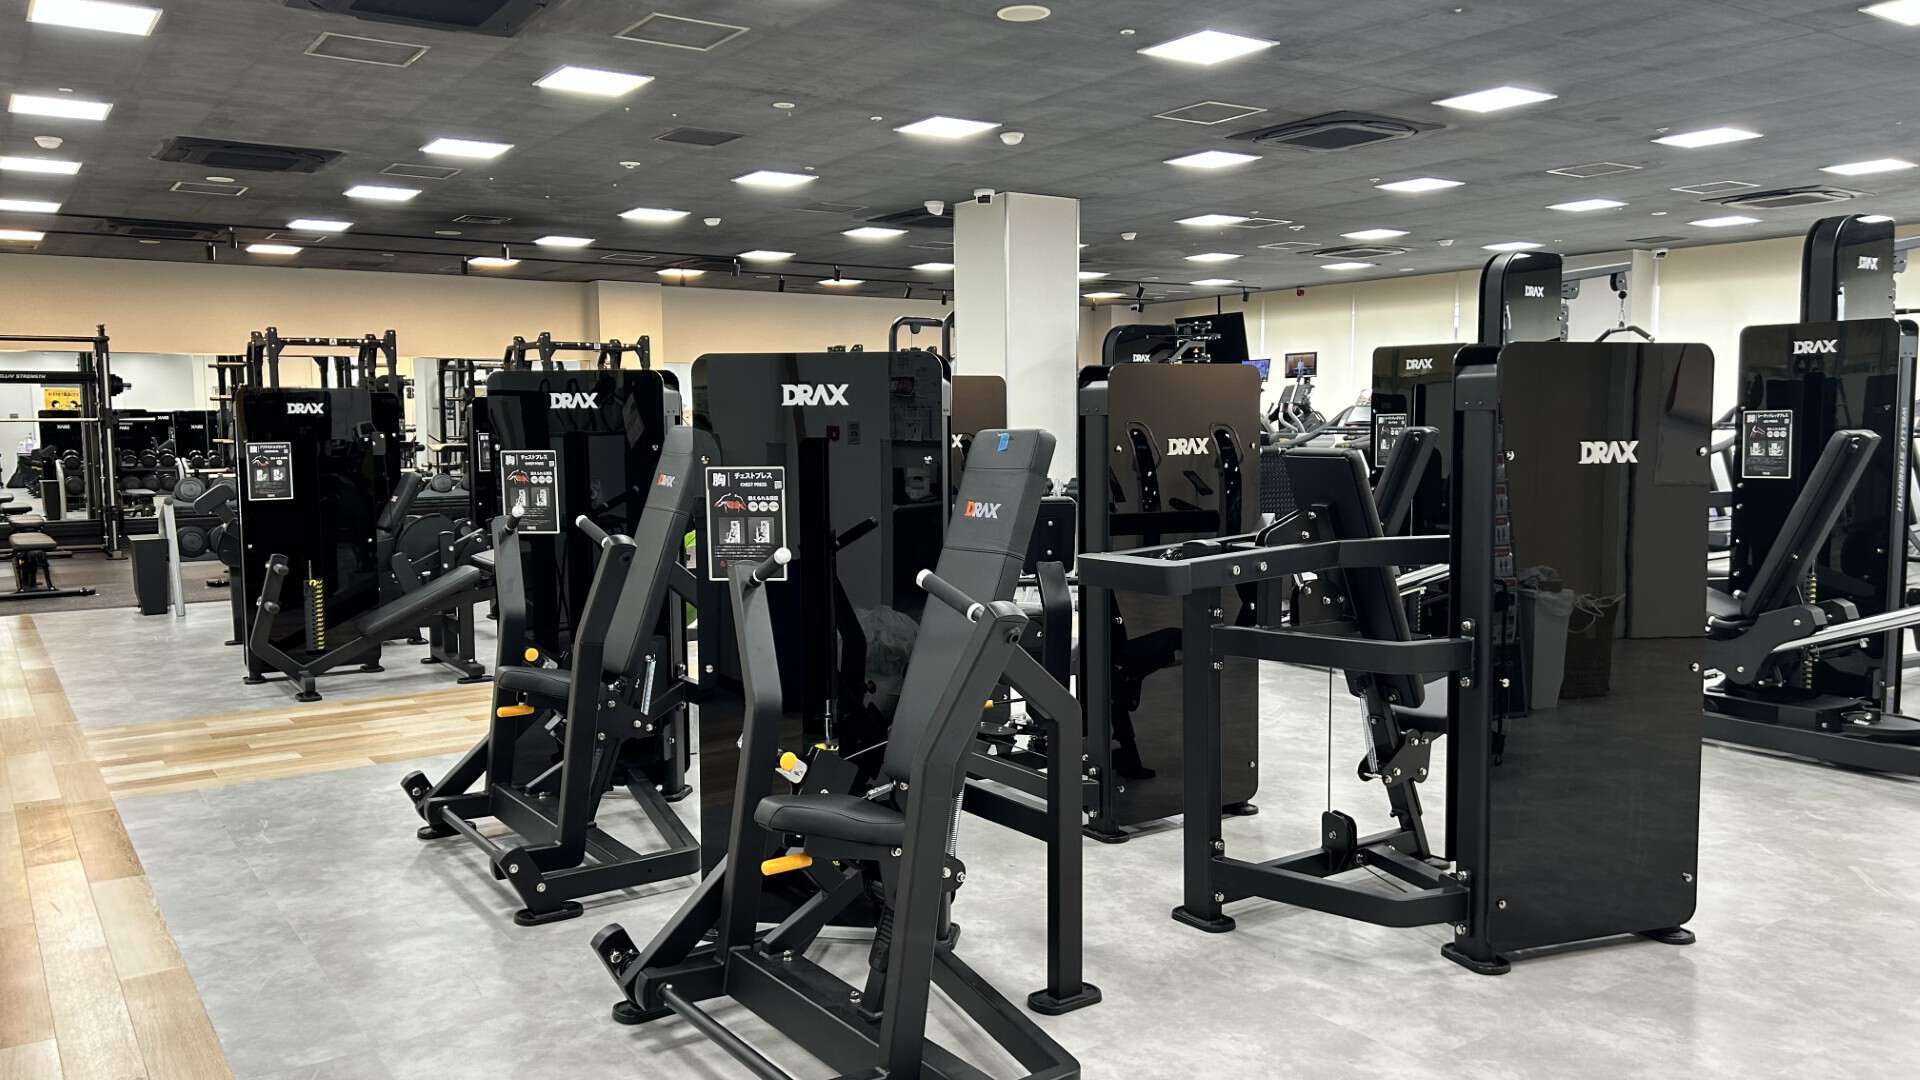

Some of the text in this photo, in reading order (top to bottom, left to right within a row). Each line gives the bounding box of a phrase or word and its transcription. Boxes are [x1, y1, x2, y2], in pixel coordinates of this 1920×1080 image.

[1524, 285, 1545, 298] DRAX
[1792, 339, 1838, 355] DRAX
[1132, 353, 1151, 363] DRAX
[1405, 358, 1433, 371] DRAX
[548, 392, 600, 409] DRAX
[780, 383, 849, 407] DRAX
[286, 402, 325, 415] DRAX
[1166, 437, 1210, 456] DRAX
[1578, 440, 1640, 465] DRAX
[712, 472, 727, 487] 胸
[733, 472, 773, 480] チェストプレス
[963, 500, 1003, 519] DRAX
